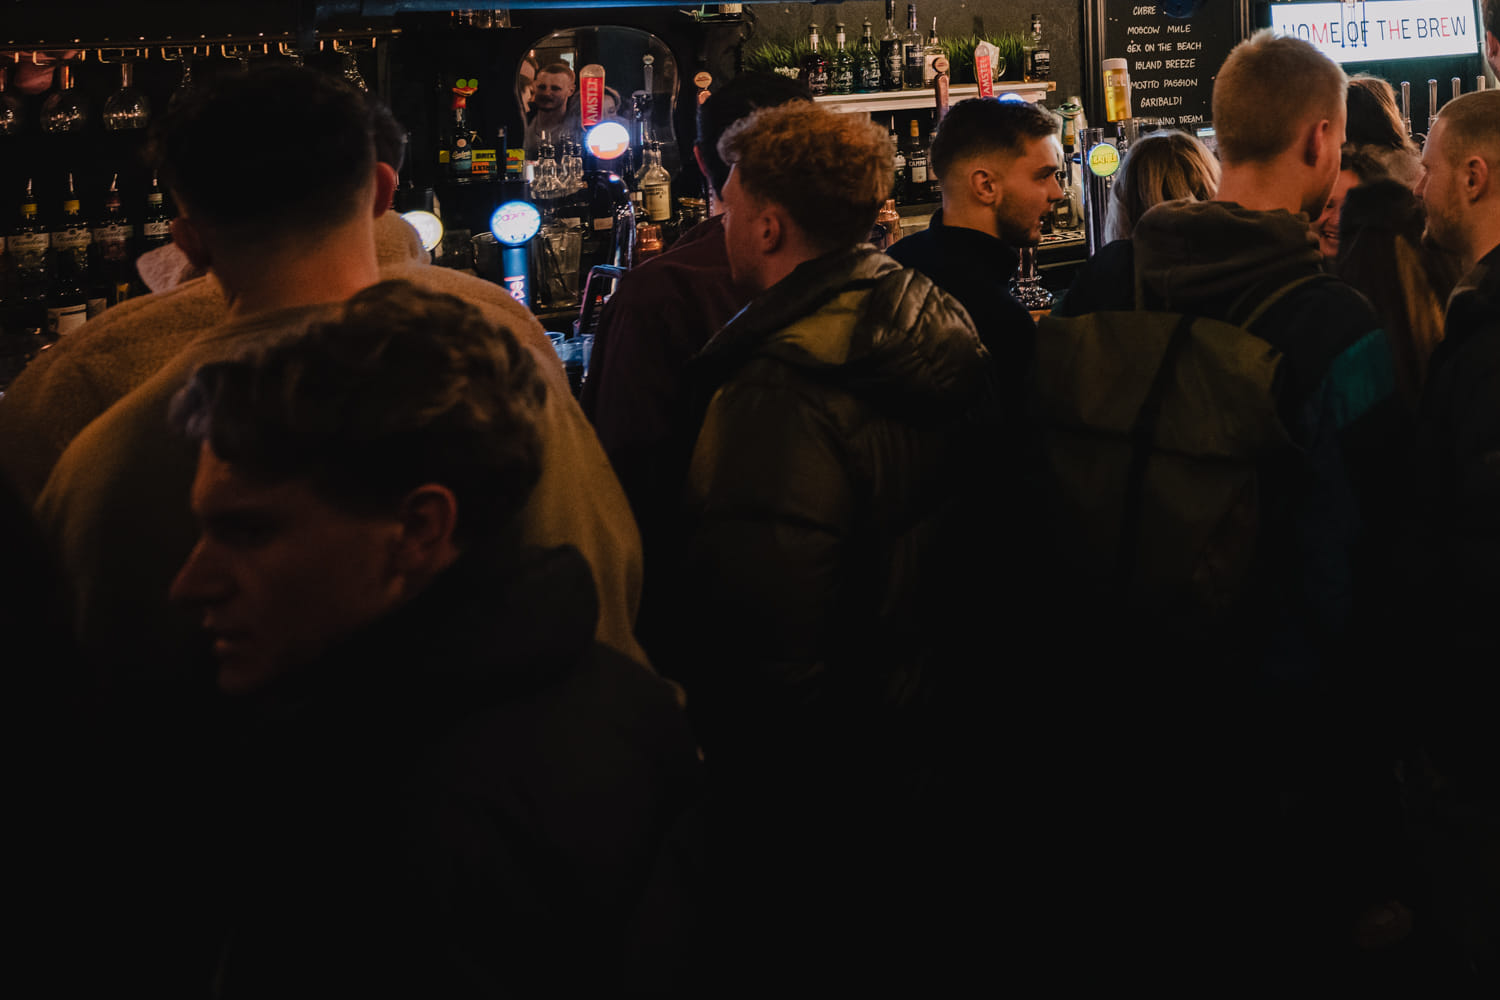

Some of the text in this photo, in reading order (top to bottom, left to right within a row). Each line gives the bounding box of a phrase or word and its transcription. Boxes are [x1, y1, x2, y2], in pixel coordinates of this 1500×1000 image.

[1127, 24, 1191, 35] MOSCOW MULE
[1347, 20, 1370, 42] OF
[1376, 18, 1411, 40] THE
[1417, 16, 1466, 38] BREW
[1127, 42, 1201, 53] SEX ON THE BEACH
[1135, 59, 1196, 70] ISLAND BREEZE
[980, 57, 991, 95] AMSTEL
[1130, 80, 1160, 90] MOJITO
[1163, 79, 1198, 88] PASSION
[586, 80, 599, 122] AMSTEL
[1140, 96, 1182, 108] GARIBALDI
[1179, 115, 1203, 124] DREAM
